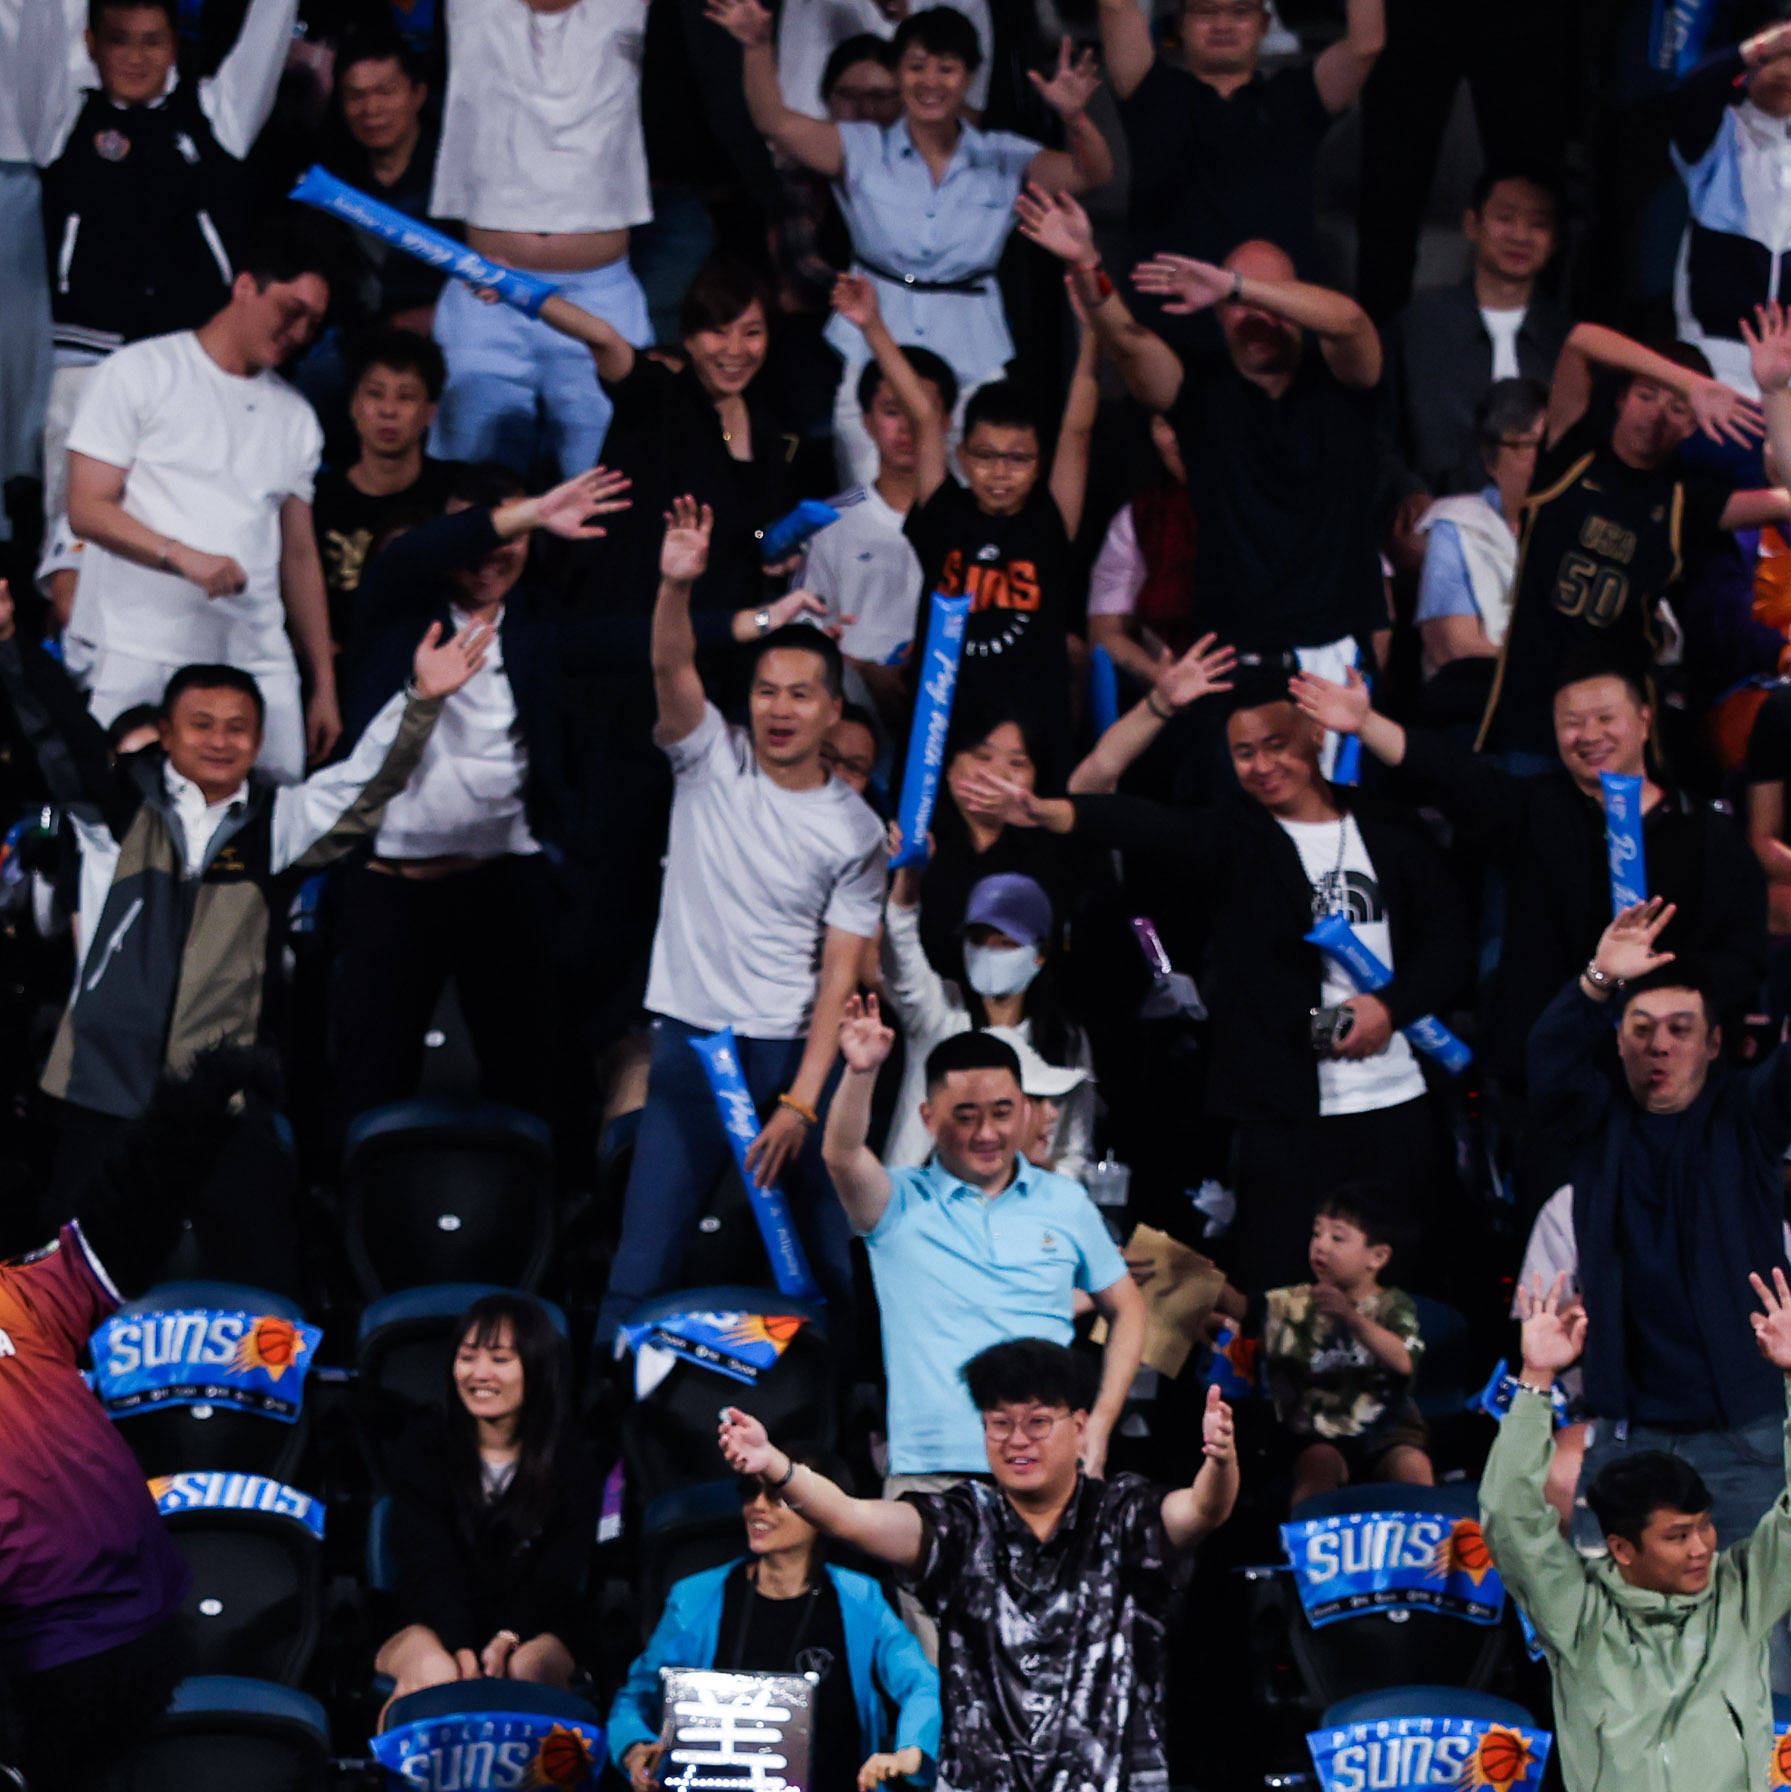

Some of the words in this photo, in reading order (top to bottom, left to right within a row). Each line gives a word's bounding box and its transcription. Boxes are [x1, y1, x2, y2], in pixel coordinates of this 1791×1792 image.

[1552, 550, 1631, 629] 50
[109, 1311, 244, 1378] SUNS
[1307, 1519, 1444, 1584] SUNS
